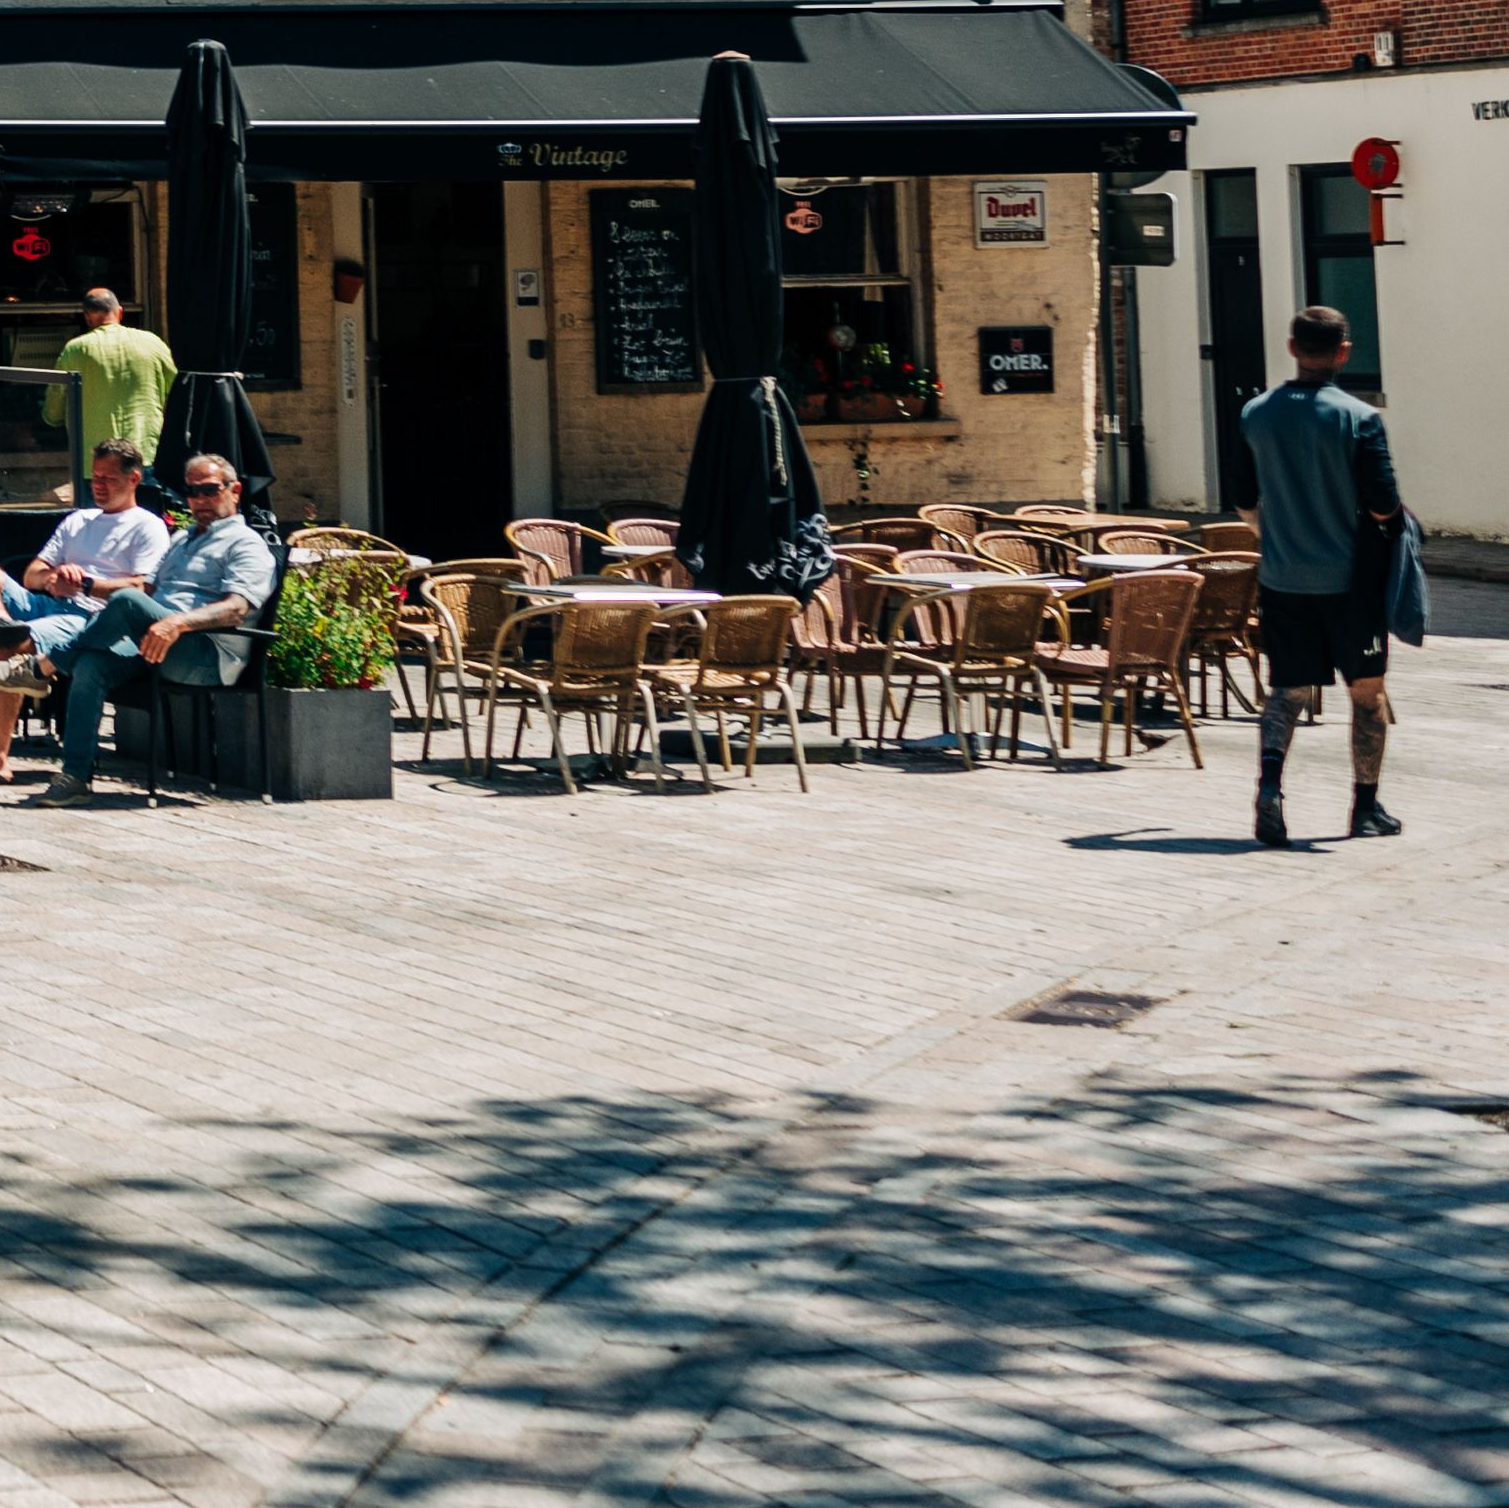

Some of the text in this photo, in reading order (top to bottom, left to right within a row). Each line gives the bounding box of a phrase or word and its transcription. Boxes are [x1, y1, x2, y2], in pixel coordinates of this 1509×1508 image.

[528, 142, 629, 172] Vintage
[986, 196, 1036, 218] Duvel
[989, 353, 1051, 372] OMER.
